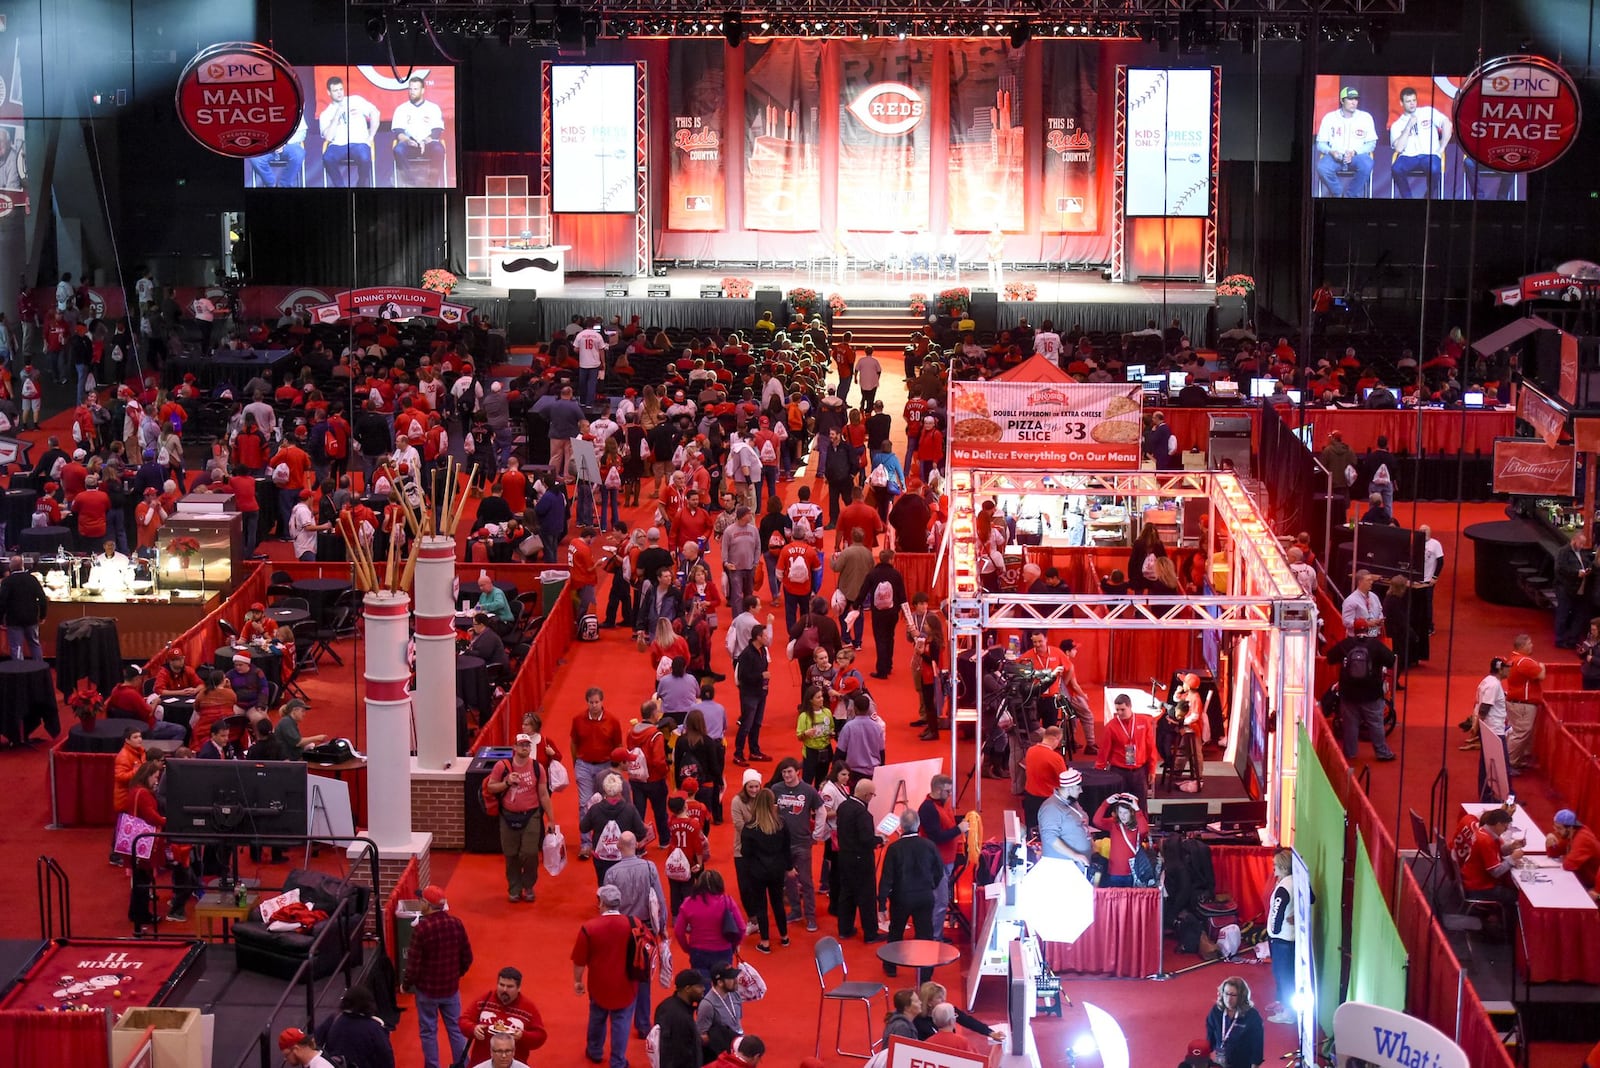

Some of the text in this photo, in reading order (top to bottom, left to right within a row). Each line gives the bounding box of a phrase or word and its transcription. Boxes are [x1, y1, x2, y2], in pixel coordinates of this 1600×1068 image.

[228, 64, 265, 77] PNC
[1513, 78, 1550, 91] PNC
[204, 88, 274, 105] MAIN
[872, 102, 922, 116] REDS
[1482, 102, 1554, 120] MAIN
[197, 106, 286, 124] STAGE
[676, 117, 701, 128] THIS IS
[1048, 118, 1074, 129] THIS IS
[560, 127, 586, 135] KIDS
[1135, 129, 1160, 138] KIDS
[1168, 130, 1202, 140] PRESS
[1470, 122, 1562, 140] STAGE
[674, 126, 719, 152] Reds
[1047, 128, 1091, 153] Reds
[690, 151, 718, 160] COUNTRY
[1062, 152, 1090, 162] COUNTRY
[1533, 279, 1551, 288] THE
[354, 294, 426, 304] DINING PAVILION
[585, 339, 593, 350] 16
[1044, 341, 1053, 352] 16
[909, 411, 921, 422] 30
[1008, 420, 1043, 430] PIZZA
[1018, 432, 1050, 441] SLICE
[1065, 422, 1087, 440] $3
[954, 450, 1137, 463] We Deliver Everything On Our Menu
[1506, 460, 1563, 474] Budweiser
[788, 547, 806, 555] VOTTO
[675, 831, 687, 848] 11
[667, 863, 686, 873] Reds
[1373, 1026, 1429, 1068] What
